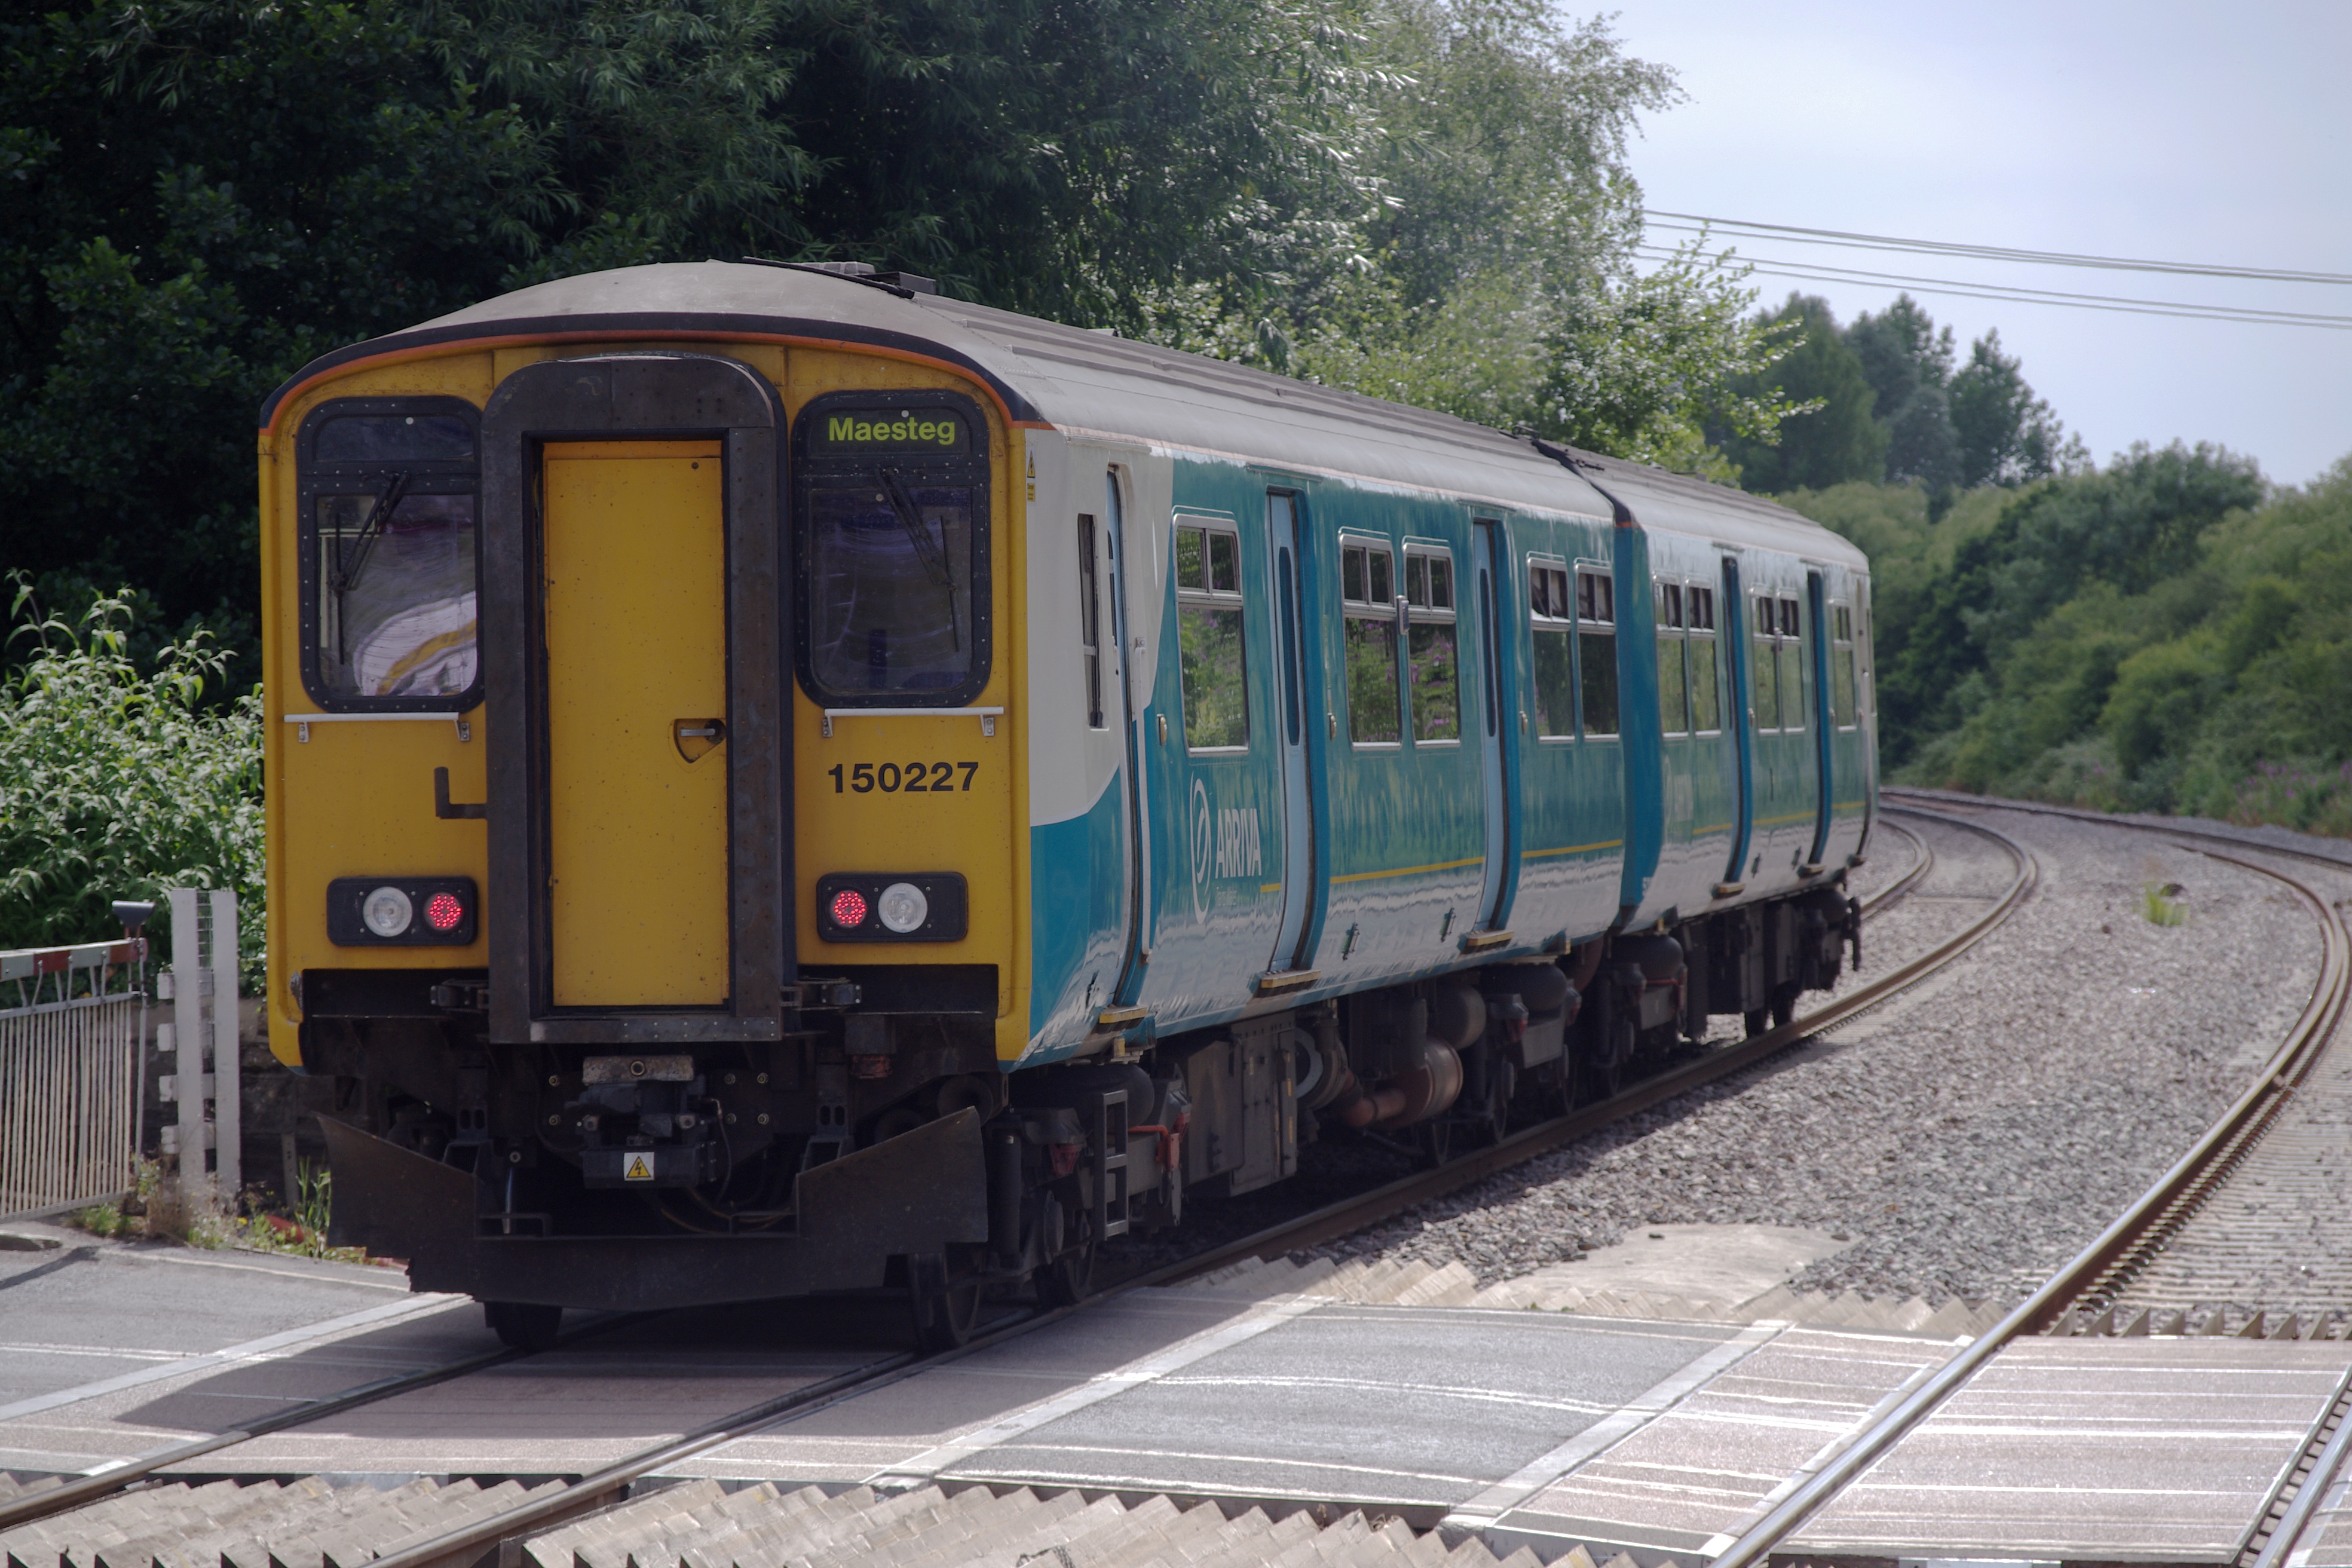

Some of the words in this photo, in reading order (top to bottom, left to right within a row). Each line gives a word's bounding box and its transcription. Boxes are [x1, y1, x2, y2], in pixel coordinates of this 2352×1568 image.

[829, 416, 955, 445] Maesteg
[828, 761, 979, 794] 150227
[1214, 808, 1262, 879] ARRIVA
